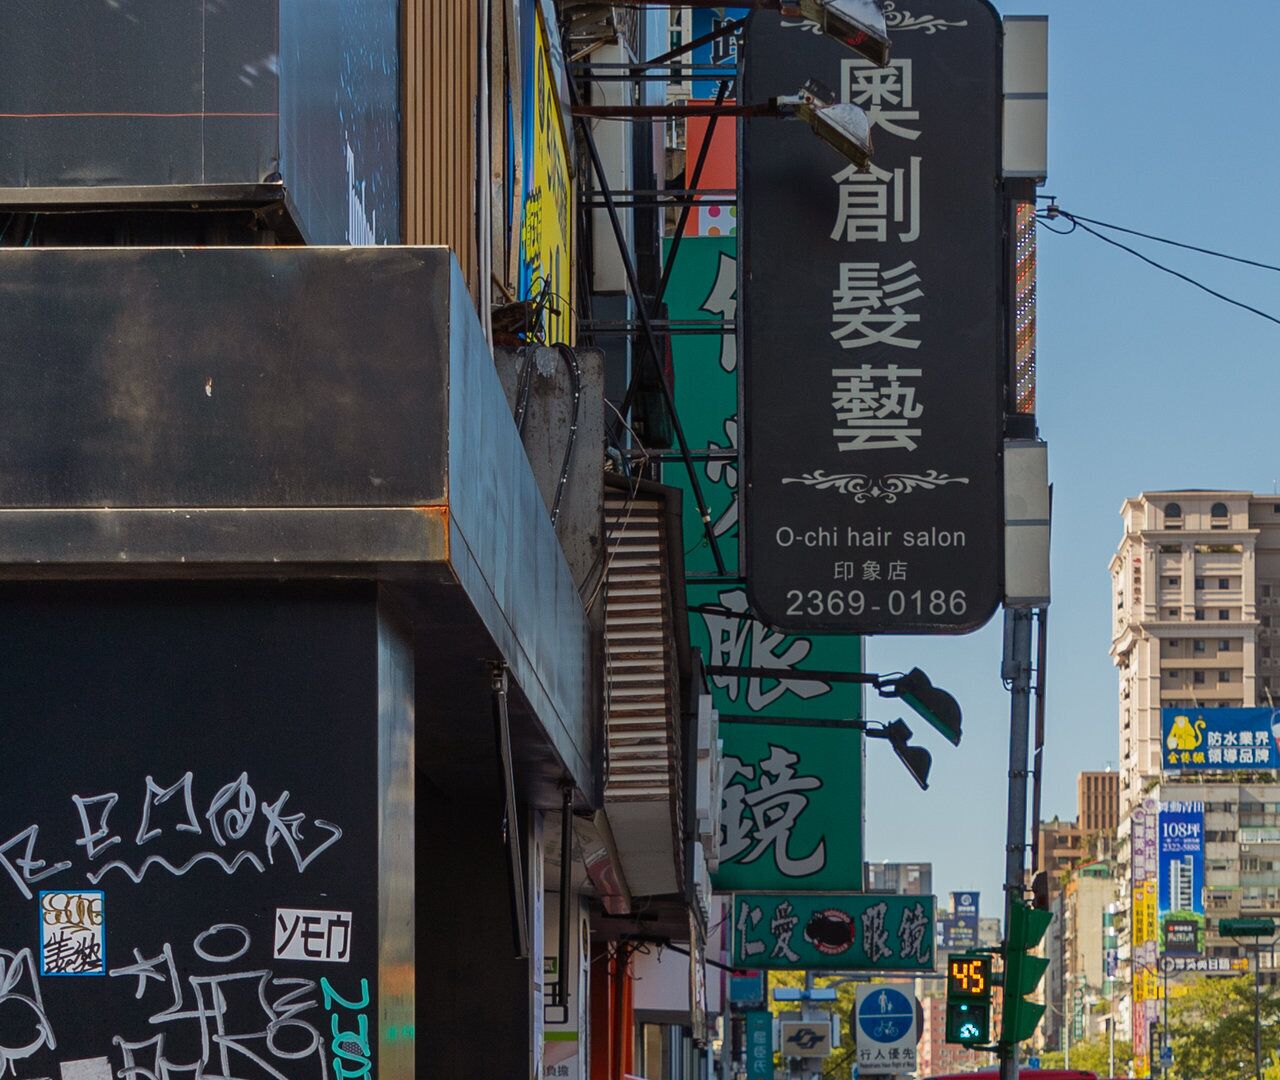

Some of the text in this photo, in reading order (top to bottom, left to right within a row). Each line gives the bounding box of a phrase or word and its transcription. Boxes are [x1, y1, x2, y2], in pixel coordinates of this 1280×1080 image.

[776, 526, 966, 547] O-chi hair salon
[833, 560, 908, 581] 印象店
[786, 589, 967, 616] 2369-0186
[1208, 731, 1269, 746] 防水業界
[952, 960, 984, 993] 45
[860, 1048, 915, 1060] 行人優先
[543, 1064, 569, 1077] 負擔
